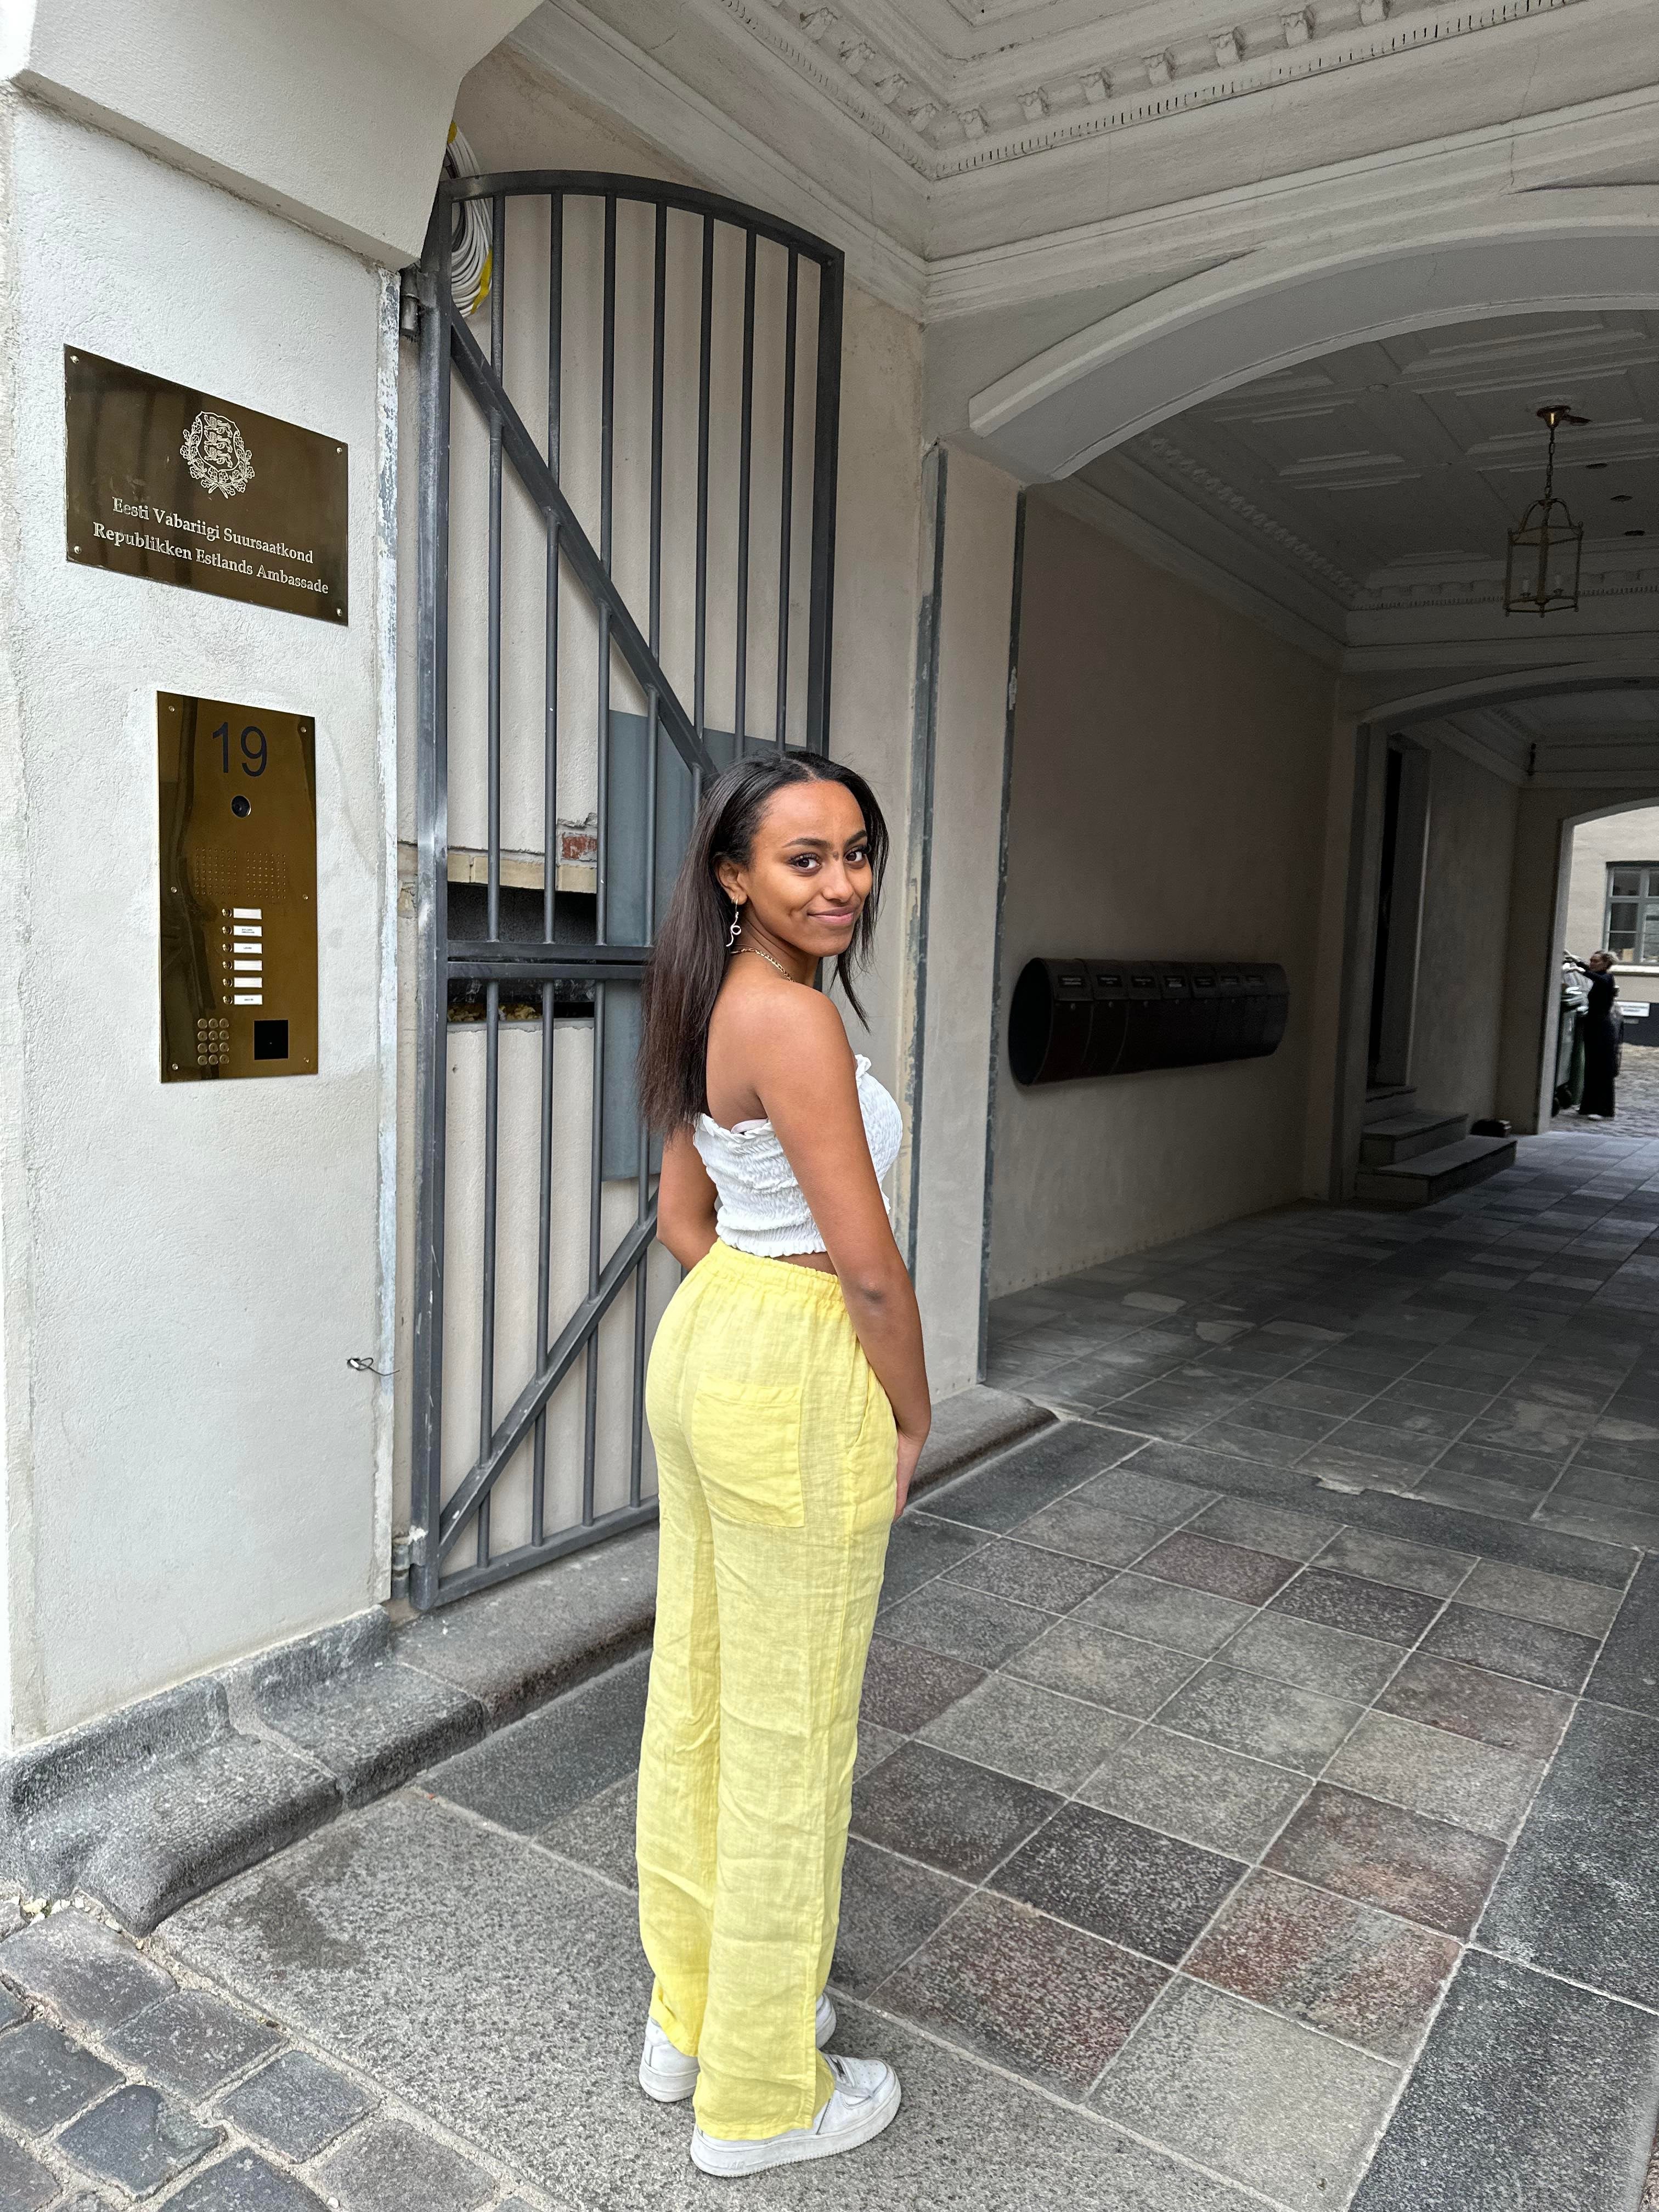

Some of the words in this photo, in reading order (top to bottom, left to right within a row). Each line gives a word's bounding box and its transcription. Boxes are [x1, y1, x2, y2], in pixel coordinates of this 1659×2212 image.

[93, 522, 192, 560] Republikken
[195, 548, 253, 575] Estlands
[256, 565, 329, 594] Ambassade
[112, 496, 149, 520] Eesti
[153, 507, 220, 541] Vabariigi
[224, 528, 313, 564] Suursaatkond
[212, 721, 267, 777] 19
